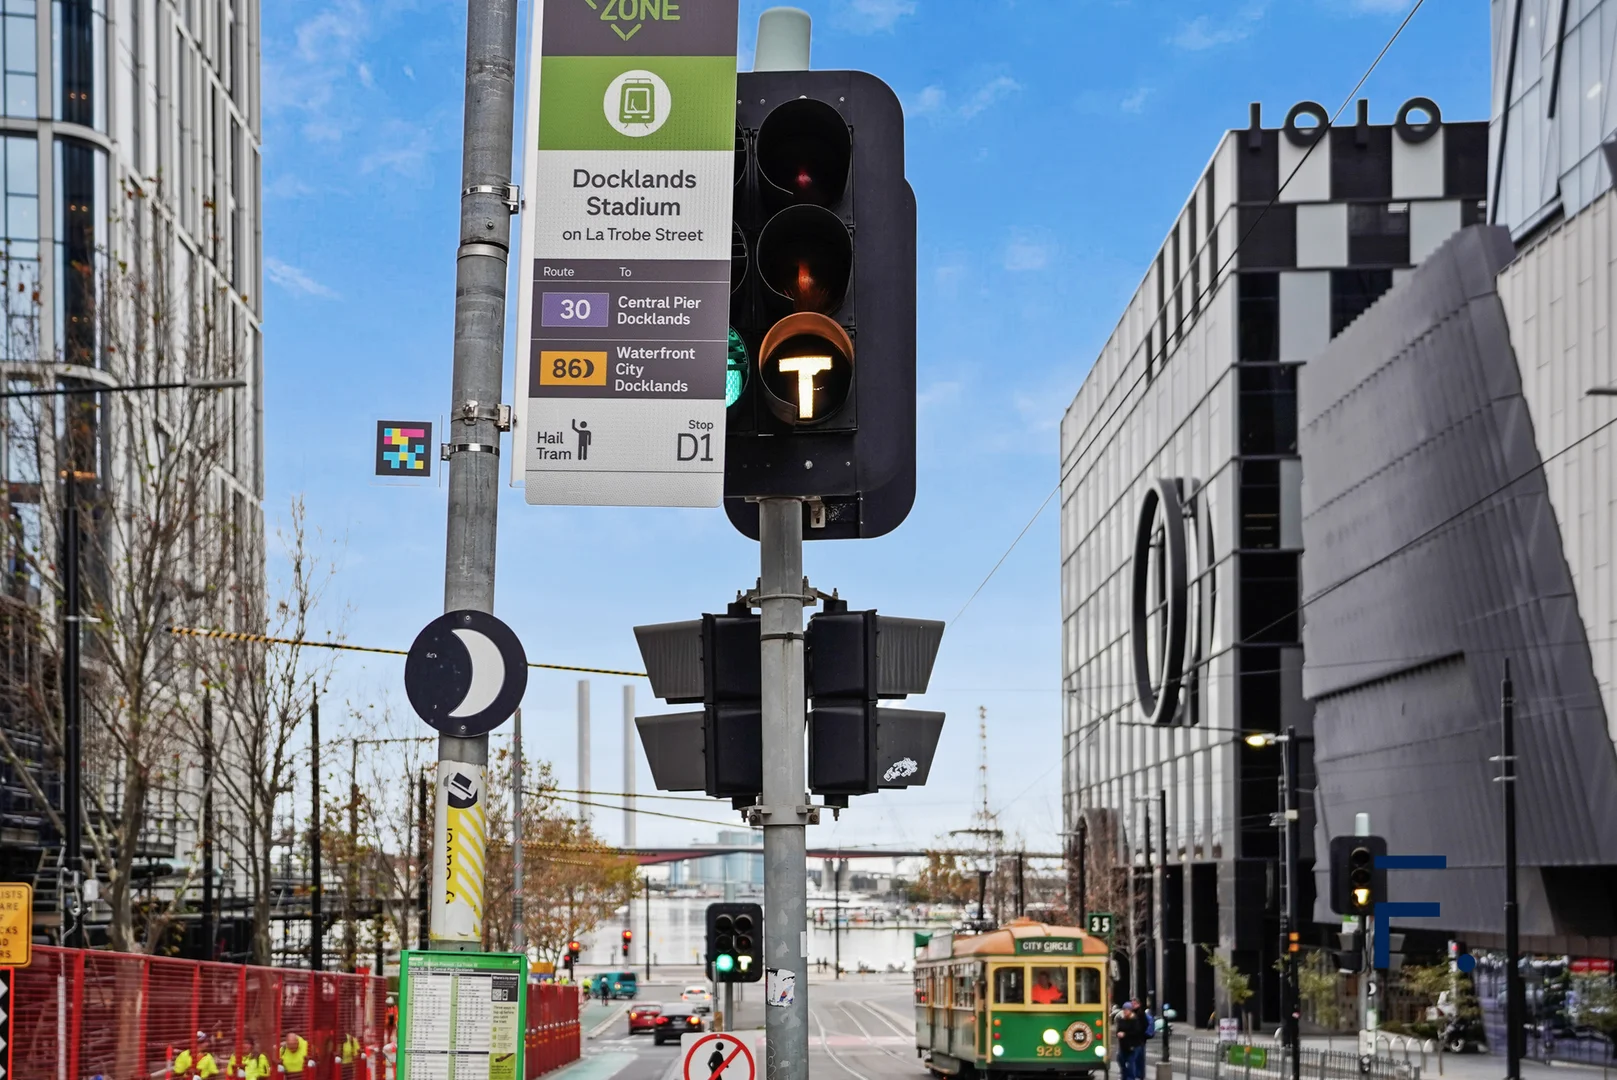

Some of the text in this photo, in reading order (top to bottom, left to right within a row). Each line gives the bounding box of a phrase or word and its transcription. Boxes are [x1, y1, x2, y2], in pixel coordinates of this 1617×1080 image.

[600, 0, 681, 21] ZONE
[573, 168, 697, 189] Docklands
[586, 196, 681, 216] Stadium
[562, 228, 704, 242] on La Trobe Street
[543, 266, 575, 277] Route
[619, 267, 632, 278] To
[560, 299, 591, 320] 30
[618, 296, 702, 309] Central Pier
[617, 312, 691, 326] Docklands
[616, 346, 696, 360] Waterfront
[552, 358, 582, 379] 86
[615, 363, 644, 377] City
[614, 379, 689, 393] Docklands
[779, 356, 832, 418] T
[688, 419, 714, 431] Stop
[537, 431, 564, 445] Hail
[536, 447, 572, 460] Tram
[677, 433, 714, 462] D1
[1091, 916, 1110, 933] 35
[1022, 941, 1074, 951] CITY CIRCLE
[1036, 1045, 1062, 1057] 928
